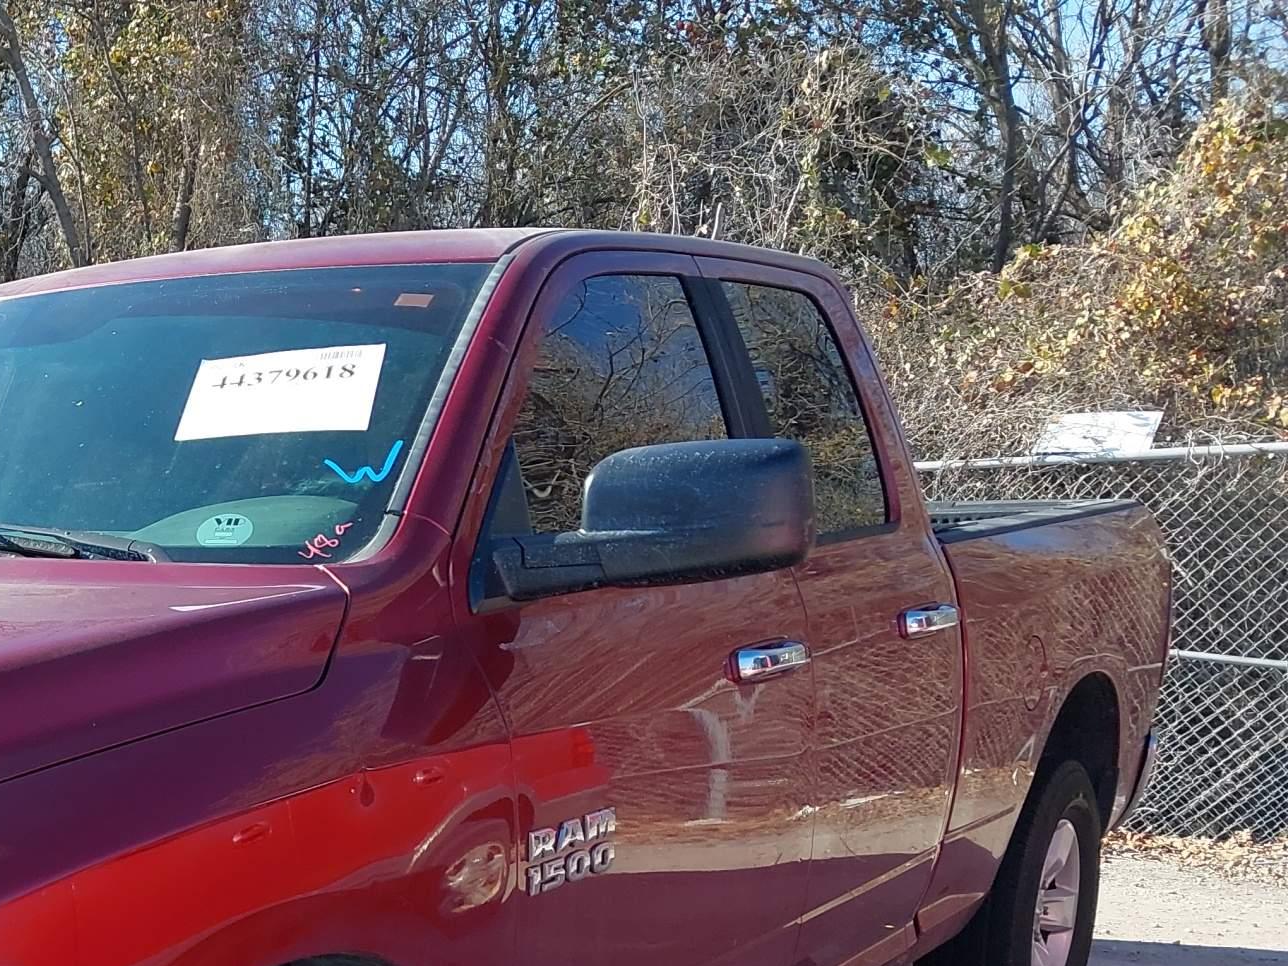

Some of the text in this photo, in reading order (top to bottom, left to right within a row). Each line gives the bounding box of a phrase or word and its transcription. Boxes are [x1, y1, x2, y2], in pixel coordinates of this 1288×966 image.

[211, 362, 356, 390] 44379618
[528, 806, 616, 864] RAM
[527, 842, 615, 896] 1500
